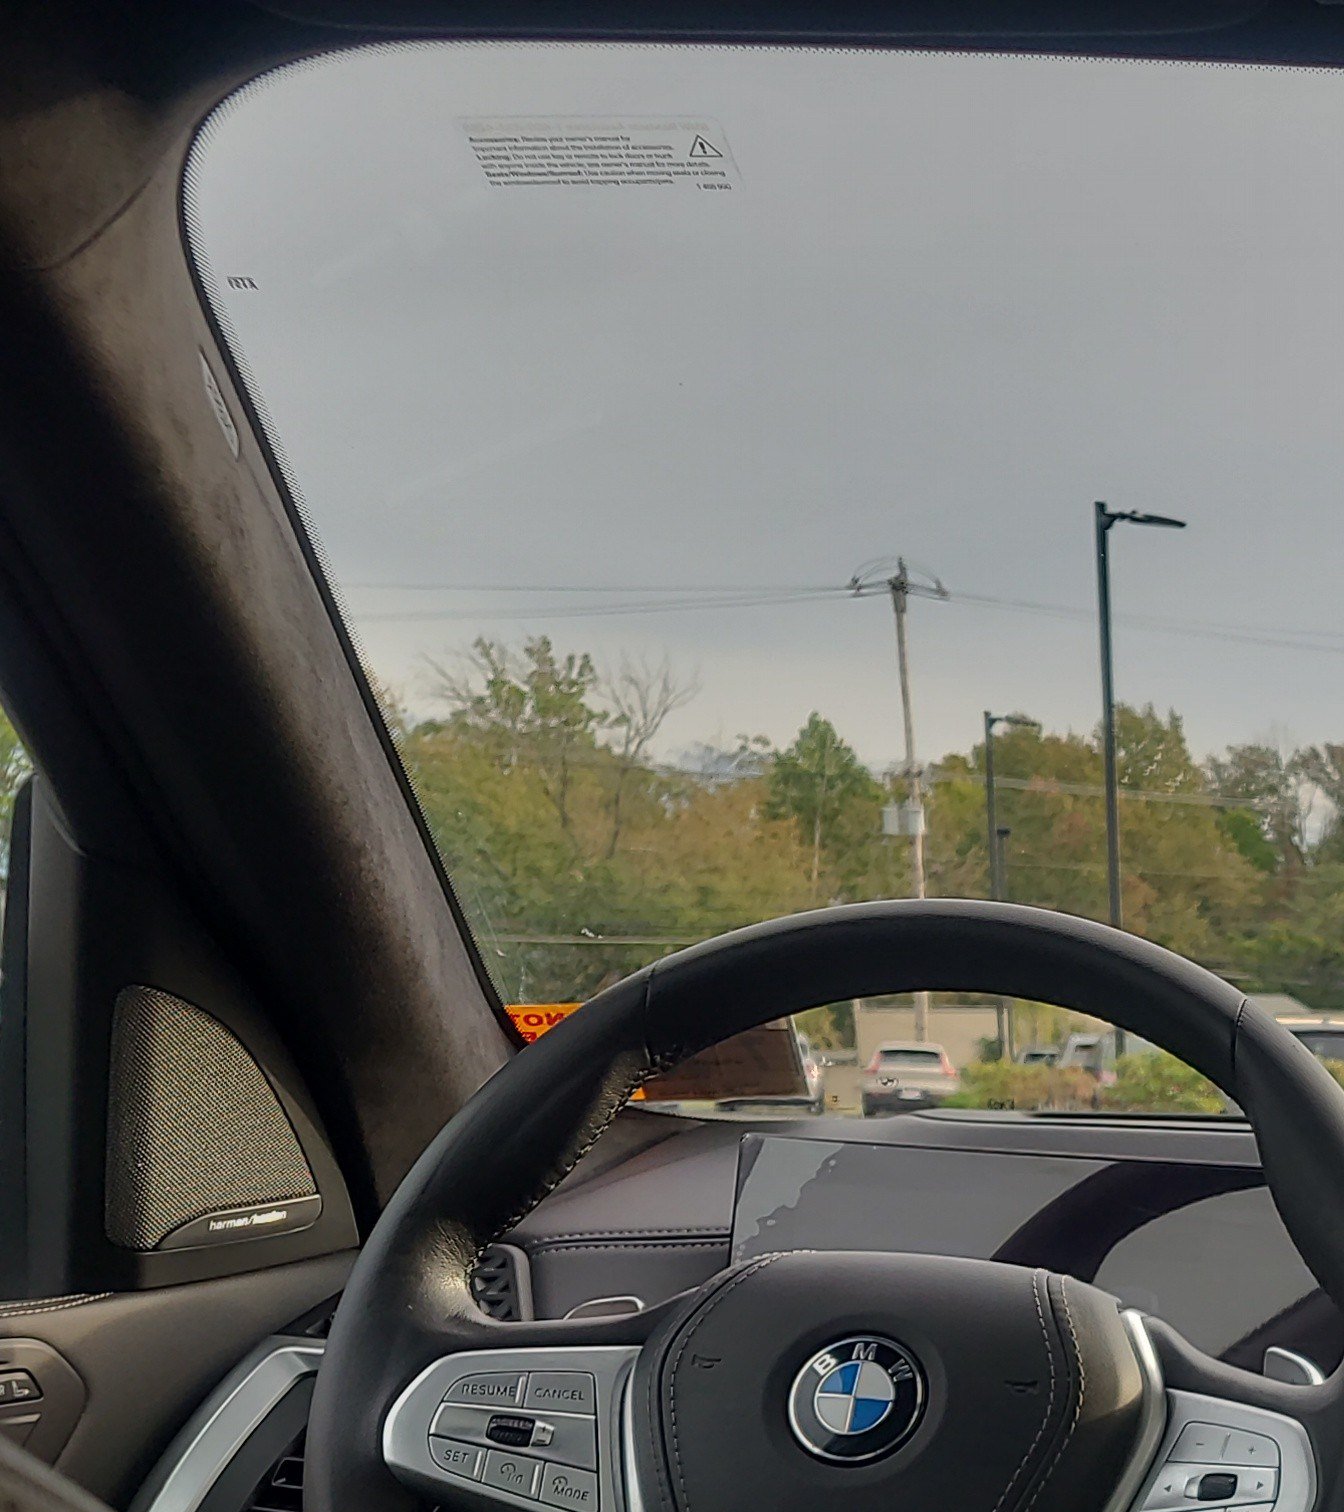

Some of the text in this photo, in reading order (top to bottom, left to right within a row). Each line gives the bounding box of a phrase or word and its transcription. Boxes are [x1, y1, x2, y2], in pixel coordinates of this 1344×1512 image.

[812, 1342, 913, 1383] BMW
[461, 1383, 516, 1397] RESUME
[534, 1387, 584, 1401] CANCEL
[443, 1450, 469, 1464] SET
[553, 1485, 590, 1501] MODE
